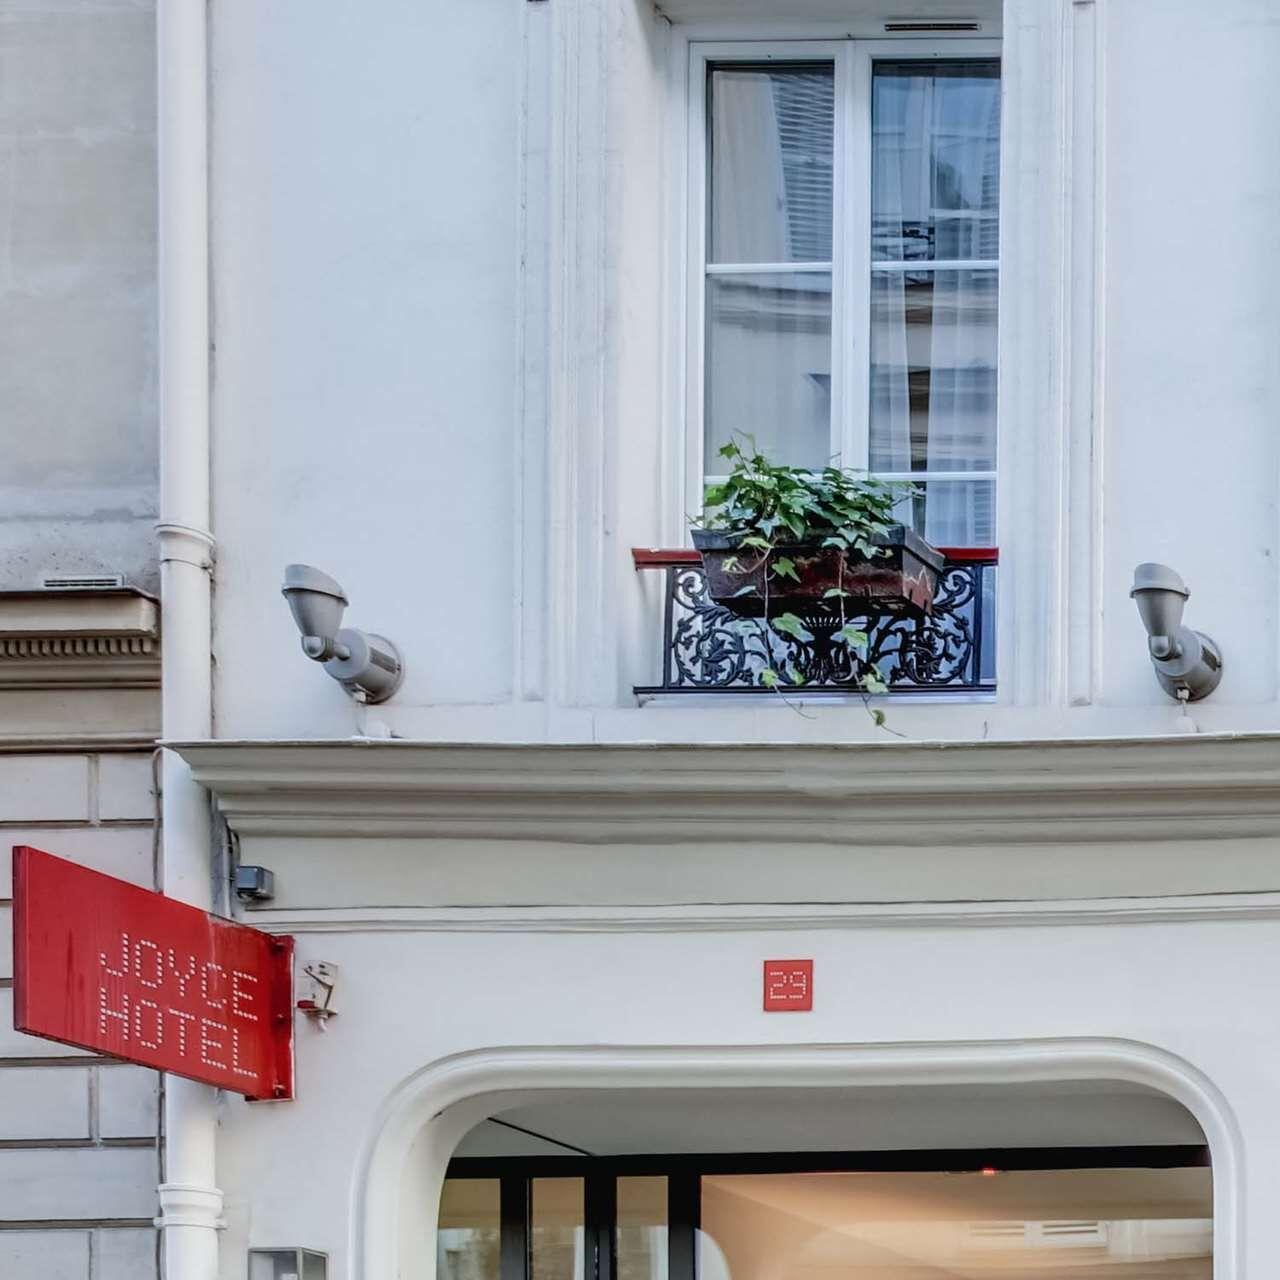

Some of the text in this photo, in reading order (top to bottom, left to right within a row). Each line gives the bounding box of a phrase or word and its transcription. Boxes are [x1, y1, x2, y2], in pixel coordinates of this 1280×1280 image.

[99, 932, 259, 1021] JOYCE
[769, 971, 807, 1000] 29
[99, 986, 259, 1079] HOTEL
